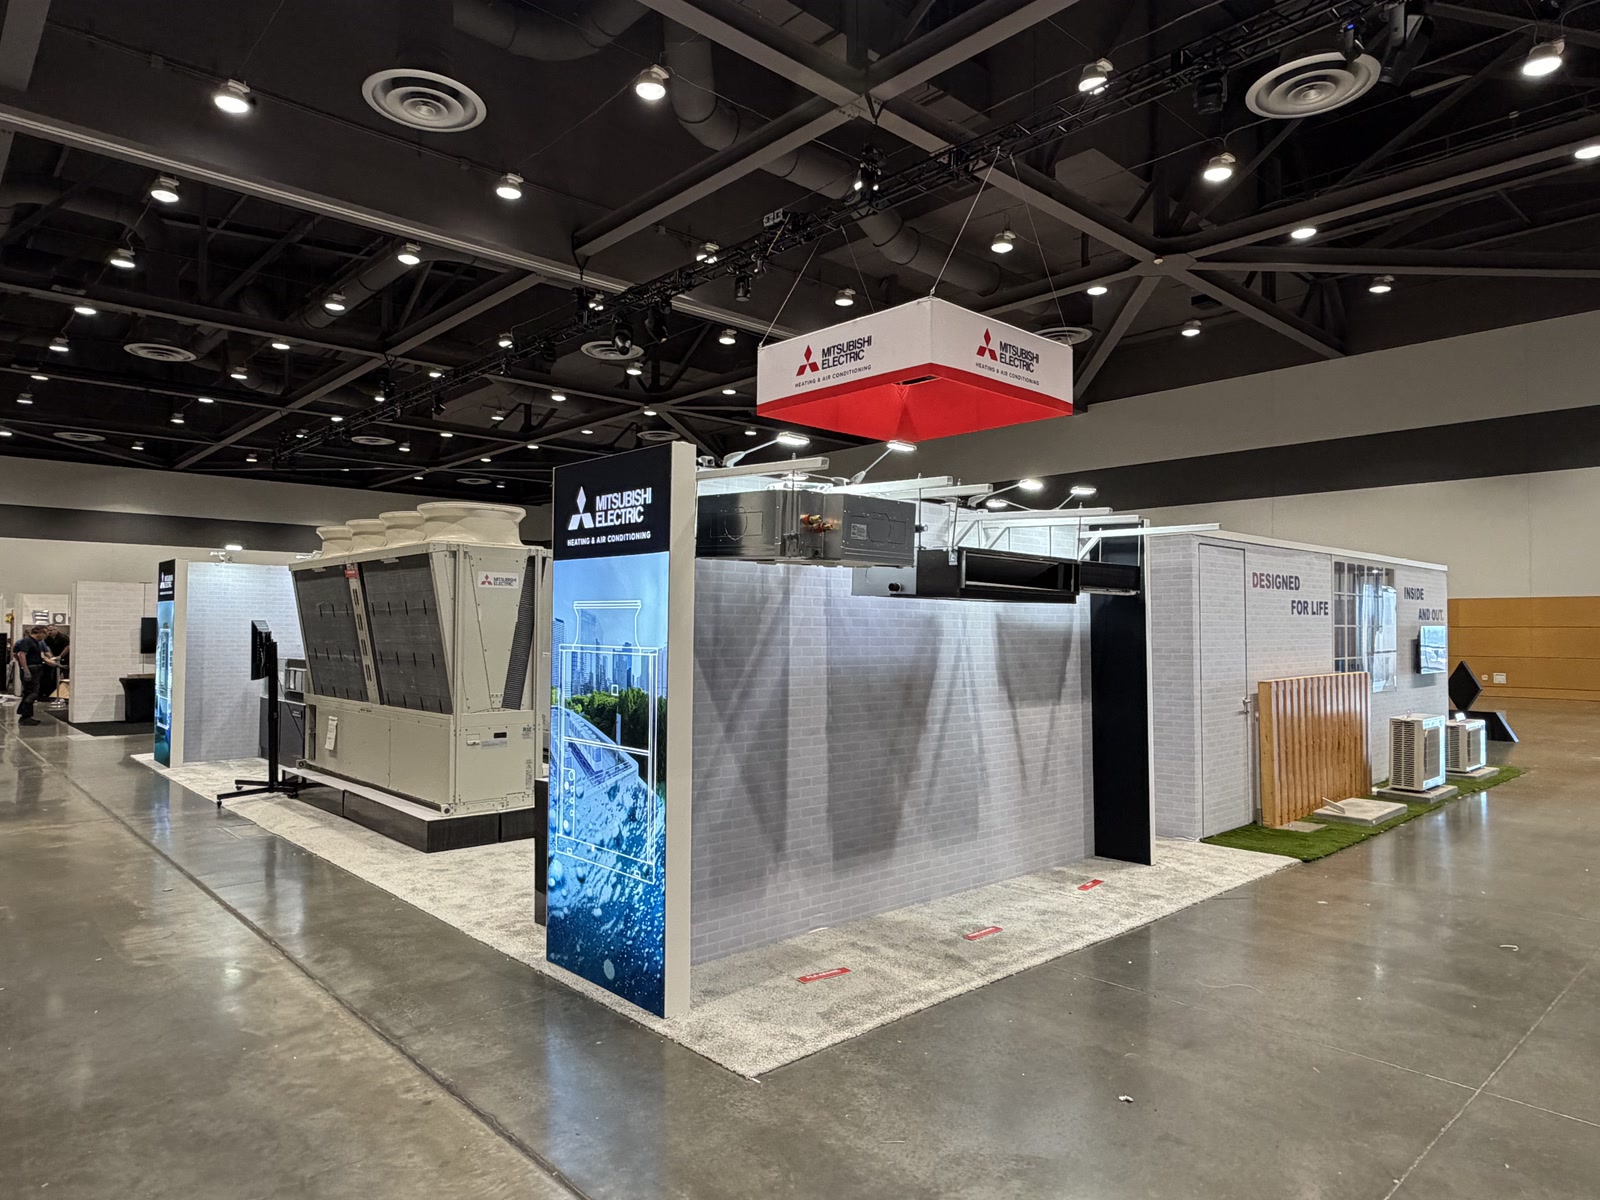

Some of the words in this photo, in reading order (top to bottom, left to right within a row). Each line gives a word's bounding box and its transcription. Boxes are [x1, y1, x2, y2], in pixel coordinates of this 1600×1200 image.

[821, 335, 872, 358] MITSUBISHI
[999, 340, 1039, 363] MITSUBISHI
[821, 349, 865, 369] ELECTRIC
[999, 353, 1034, 373] ELECTRIC
[795, 378, 816, 388] HEATING
[832, 364, 871, 380] CONDITIONING
[975, 362, 995, 372] HEATING
[1009, 371, 1040, 386] CONDITIONING
[595, 487, 652, 511] MITSUBISHI
[595, 506, 644, 528] ELECTRIC
[567, 537, 590, 546] HEATING
[596, 535, 606, 544] AIR
[607, 530, 651, 542] CONDITIONING
[1252, 572, 1301, 591] DESIGNED
[1403, 586, 1424, 601] INSIDE
[1291, 600, 1309, 615] FOR
[1311, 601, 1329, 616] LIFE
[1418, 608, 1430, 621] AND
[1431, 609, 1444, 621] OUT.
